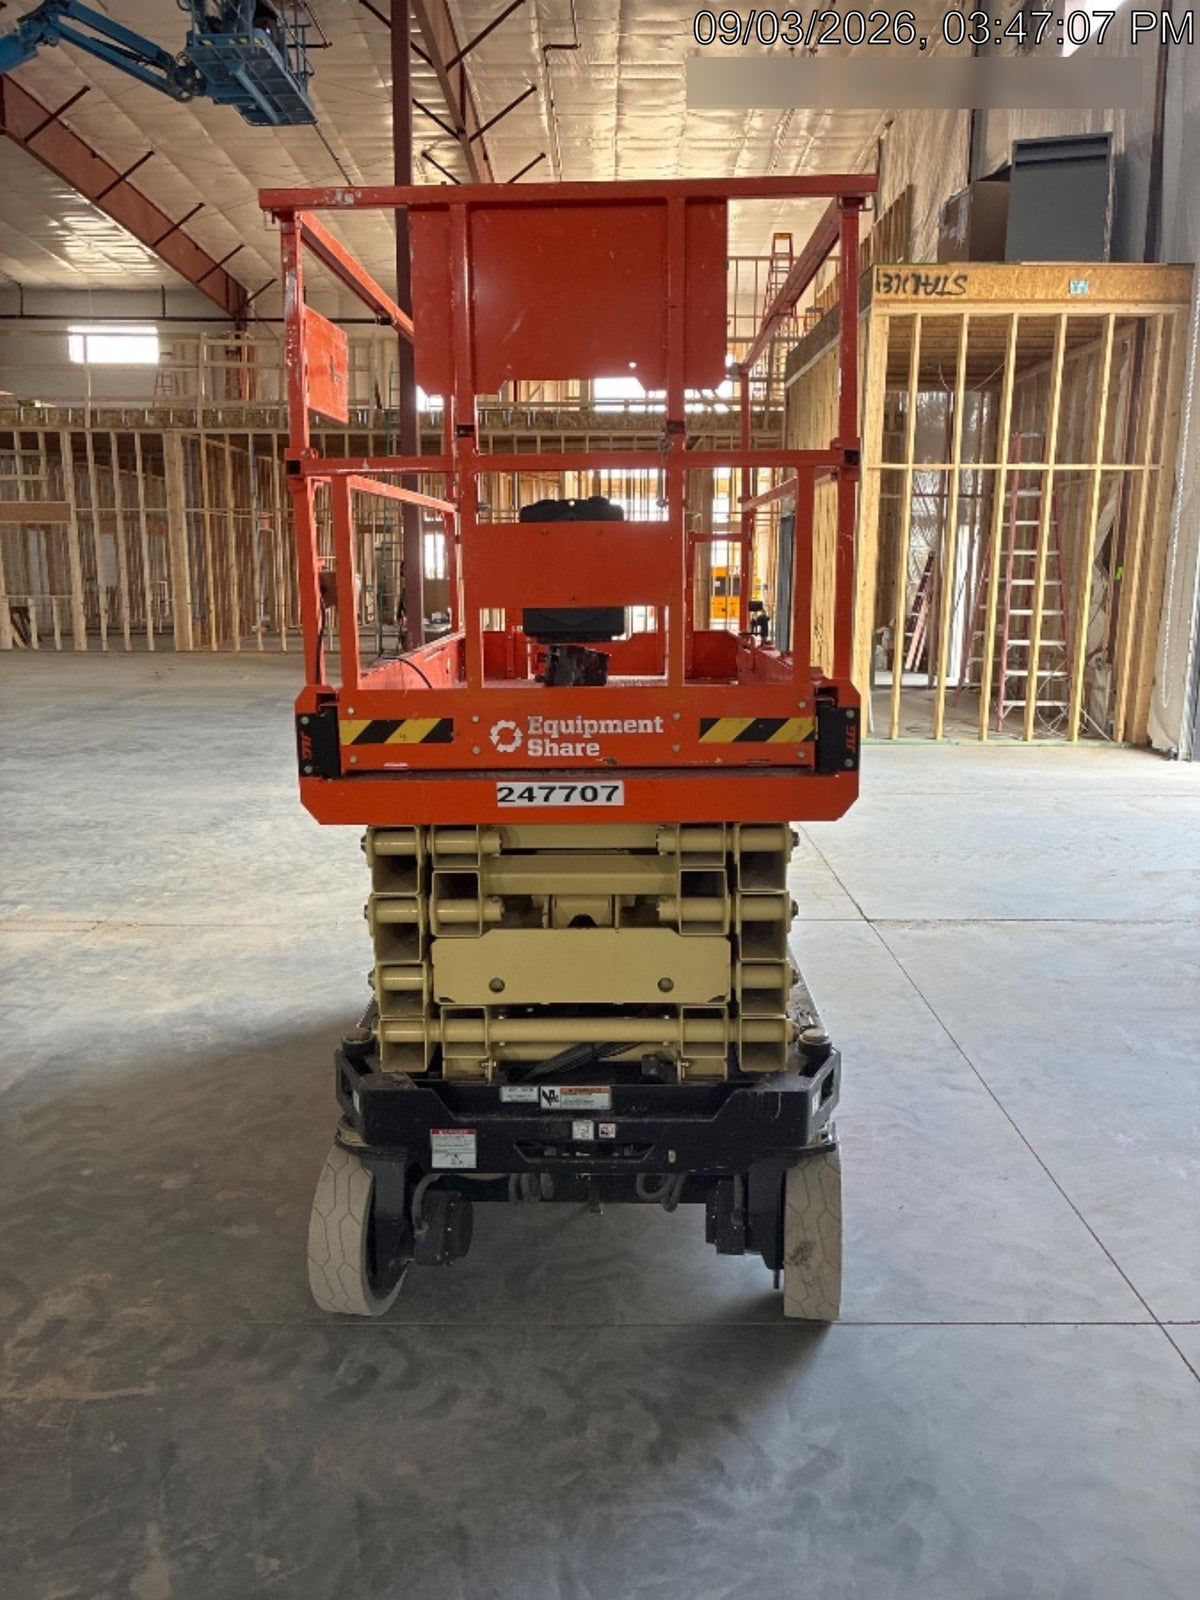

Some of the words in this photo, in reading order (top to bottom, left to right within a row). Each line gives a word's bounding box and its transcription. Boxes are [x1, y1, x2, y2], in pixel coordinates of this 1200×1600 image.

[527, 715, 664, 738] Equipment
[527, 738, 601, 757] Share
[497, 784, 620, 803] 247707
